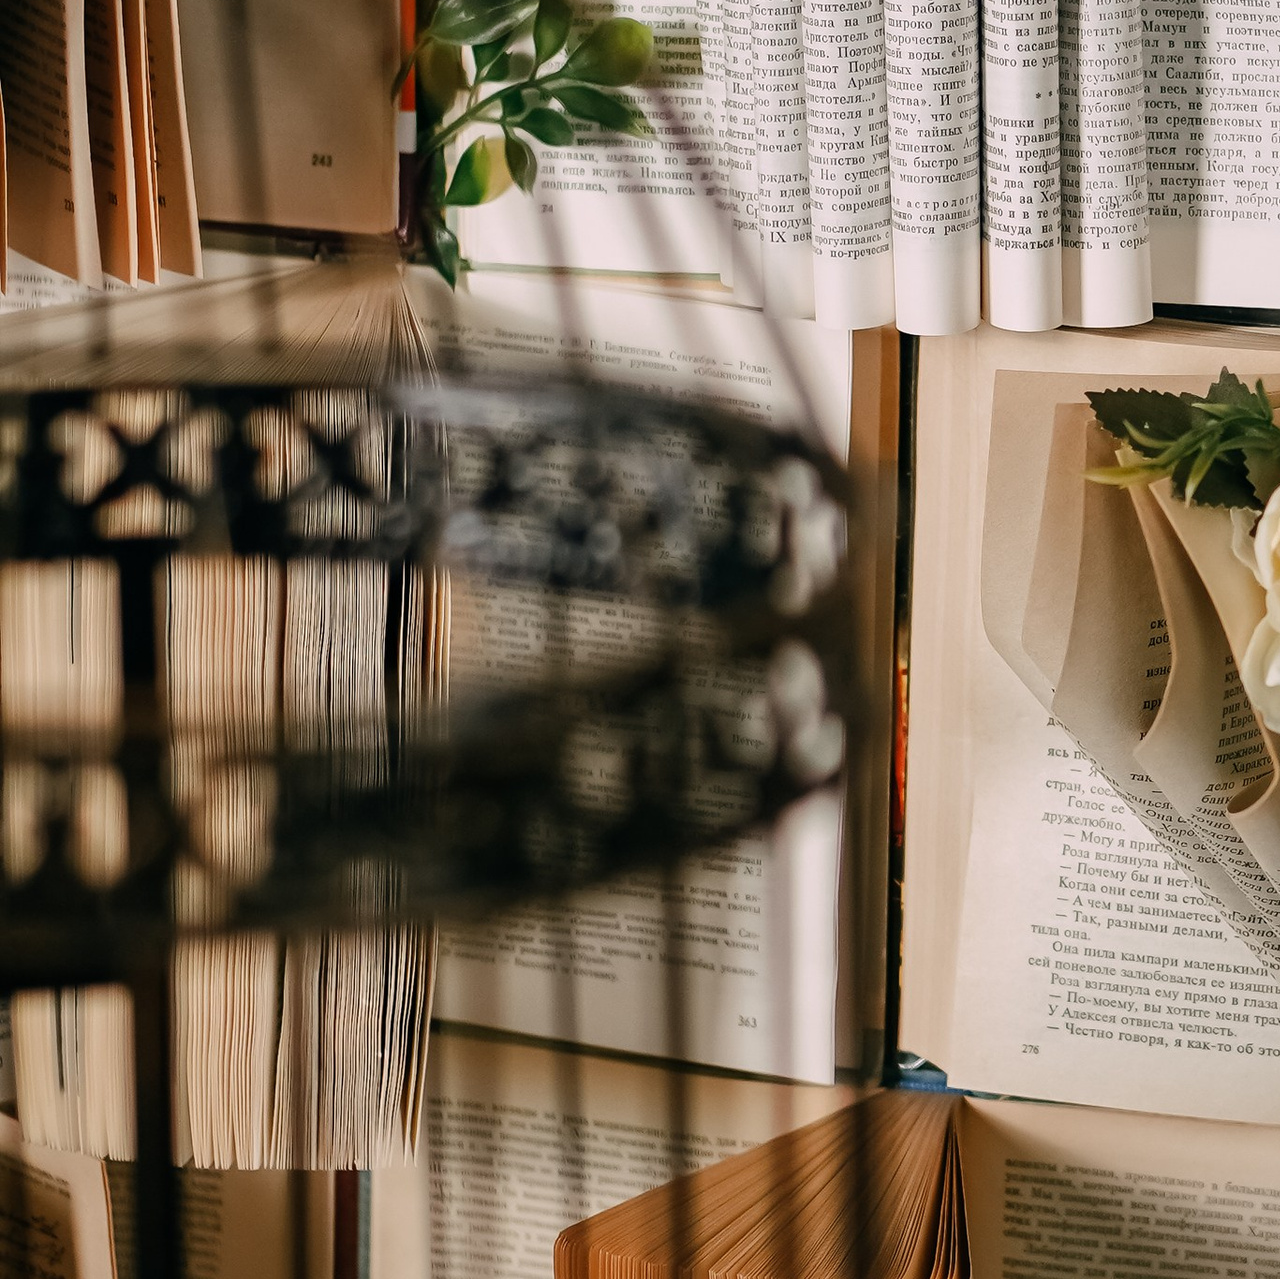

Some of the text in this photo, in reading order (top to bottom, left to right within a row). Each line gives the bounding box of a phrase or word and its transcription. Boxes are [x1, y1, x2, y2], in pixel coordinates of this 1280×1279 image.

[1207, 160, 1244, 174] Когда
[1068, 795, 1124, 814] Голос ее
[1041, 812, 1126, 832] дружелюбно.
[1062, 843, 1090, 859] Роза
[1095, 852, 1158, 869] взглянула
[1077, 862, 1149, 883] Почему бы
[1059, 876, 1160, 900] Когда они сели
[1088, 899, 1221, 923] чем вы занимаетесь
[1052, 941, 1268, 977] Она пила кампари маленькими
[1051, 972, 1080, 987] Роза
[1085, 980, 1150, 996] взглянула
[1184, 992, 1226, 1004] прямо
[738, 1015, 757, 1028] 363
[1061, 1007, 1237, 1037] Алексея отвисла челюсть.
[1066, 1022, 1232, 1052] Честно говоря, как-то
[1022, 1044, 1039, 1055] 276
